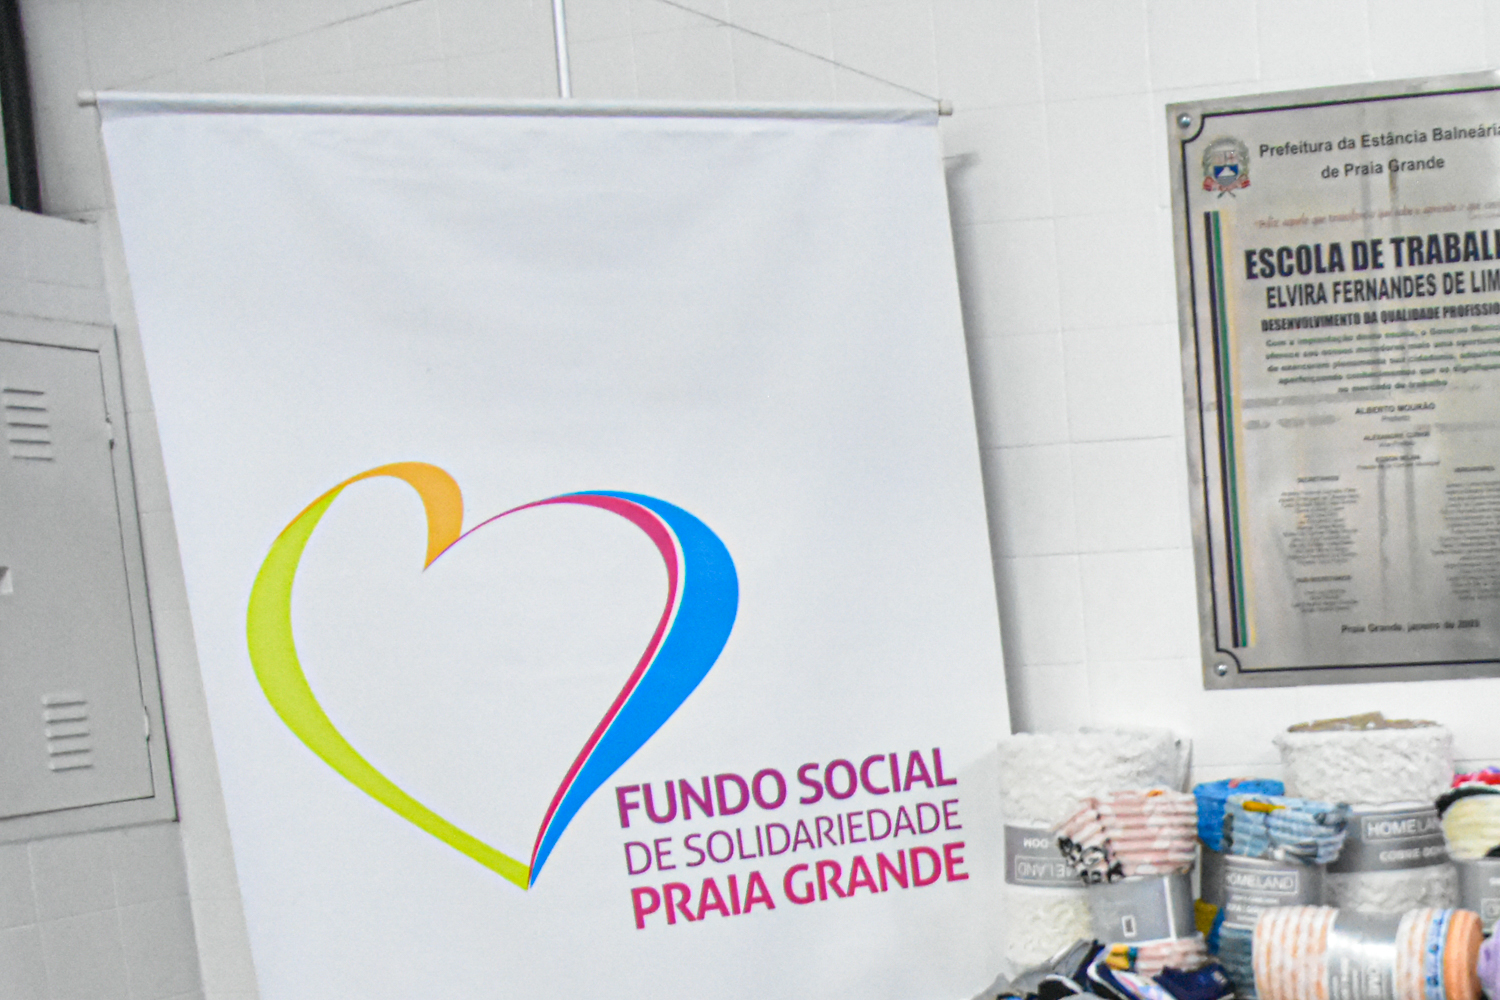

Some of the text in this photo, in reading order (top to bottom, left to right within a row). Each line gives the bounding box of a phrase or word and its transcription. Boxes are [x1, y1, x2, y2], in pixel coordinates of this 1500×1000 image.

[1259, 141, 1333, 158] Prefeitura
[1338, 136, 1356, 150] da
[1361, 131, 1428, 148] Estância
[1321, 156, 1445, 179] de Praia Grande
[1244, 242, 1345, 280] ESCOLA
[1351, 238, 1385, 271] DE
[1266, 282, 1328, 309] ELVIRA
[1333, 273, 1437, 304] FERNANDES
[1443, 271, 1465, 295] DE
[1261, 312, 1361, 332] DESENVOLVIMENTO
[1381, 306, 1440, 324] QUALIDADE
[615, 747, 958, 829] FUNDO SOCIAL
[624, 798, 963, 876] DE SOLIDARIEDADE
[1367, 817, 1441, 837] HOMELA
[630, 841, 970, 930] PRAIA GRANDE
